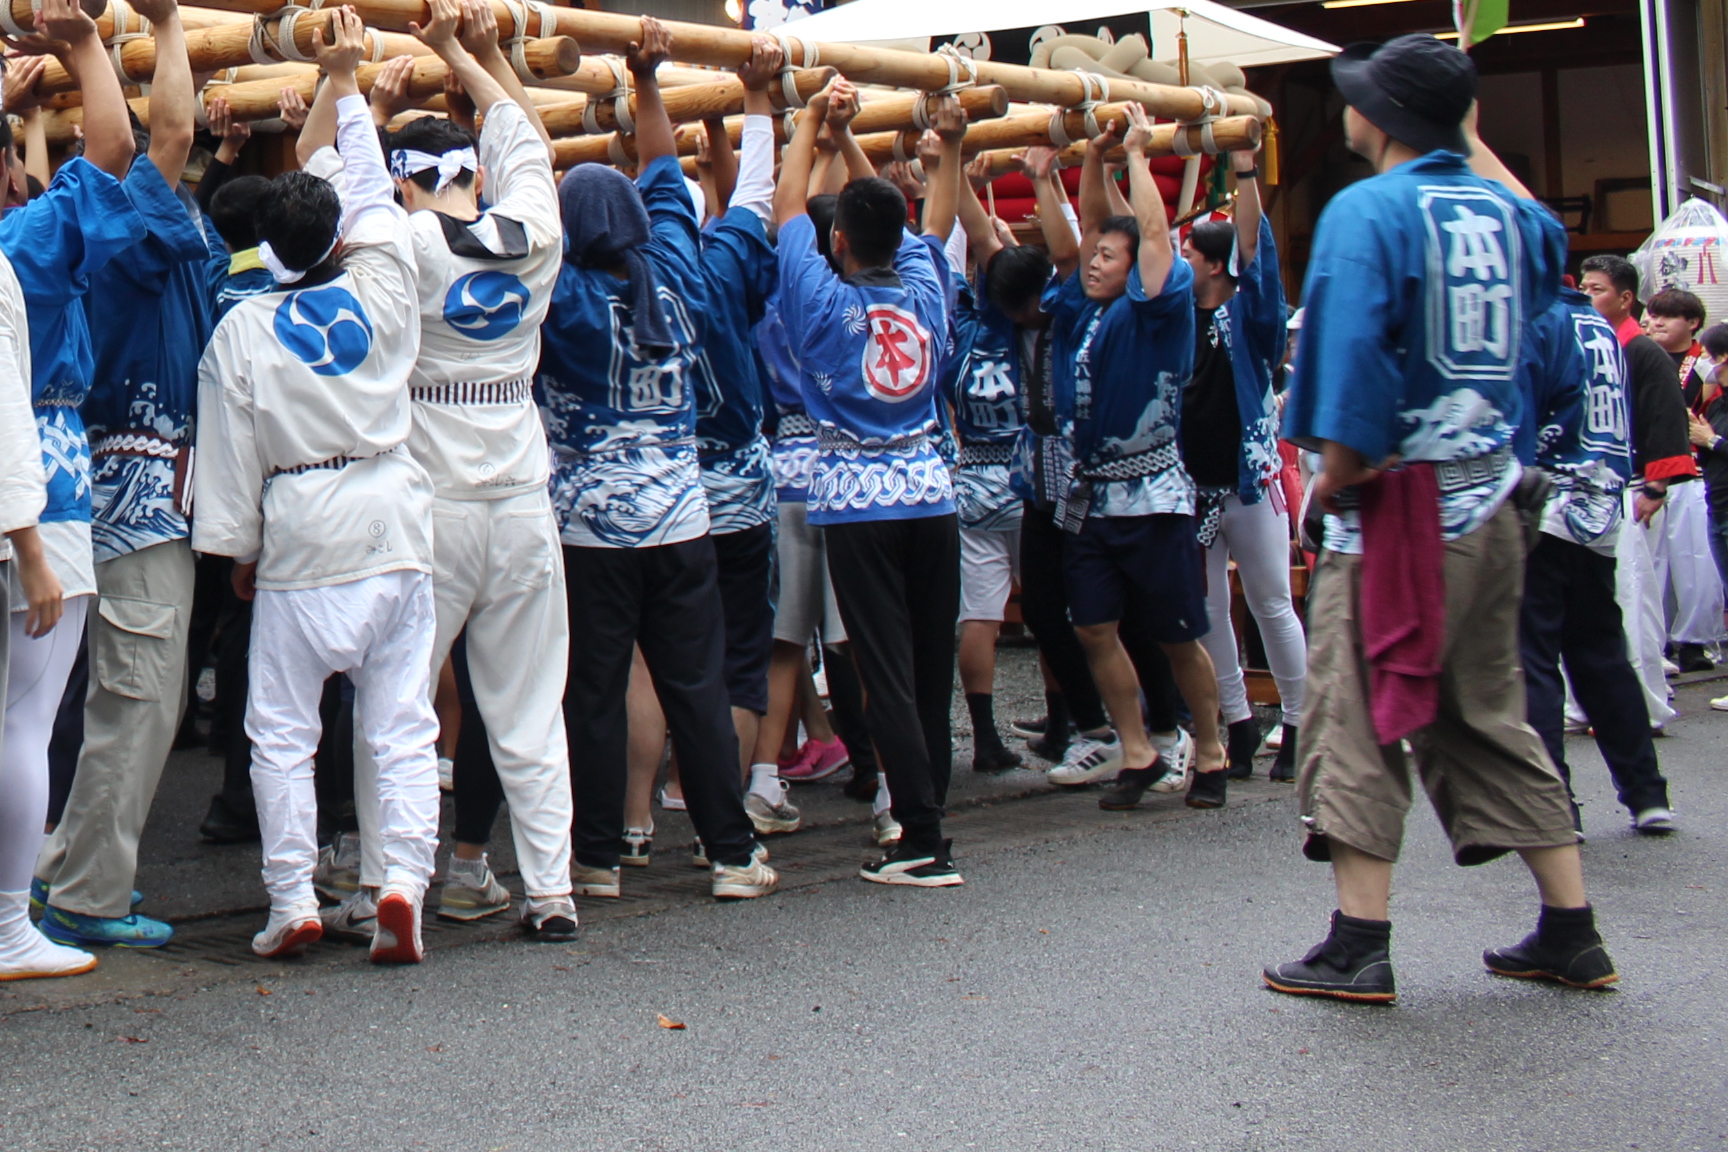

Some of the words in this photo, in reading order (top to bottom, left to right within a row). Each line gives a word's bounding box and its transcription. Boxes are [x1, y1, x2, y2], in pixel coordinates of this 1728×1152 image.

[1442, 205, 1513, 361] 本町
[967, 360, 1019, 429] 本町
[1584, 327, 1625, 441] 本町
